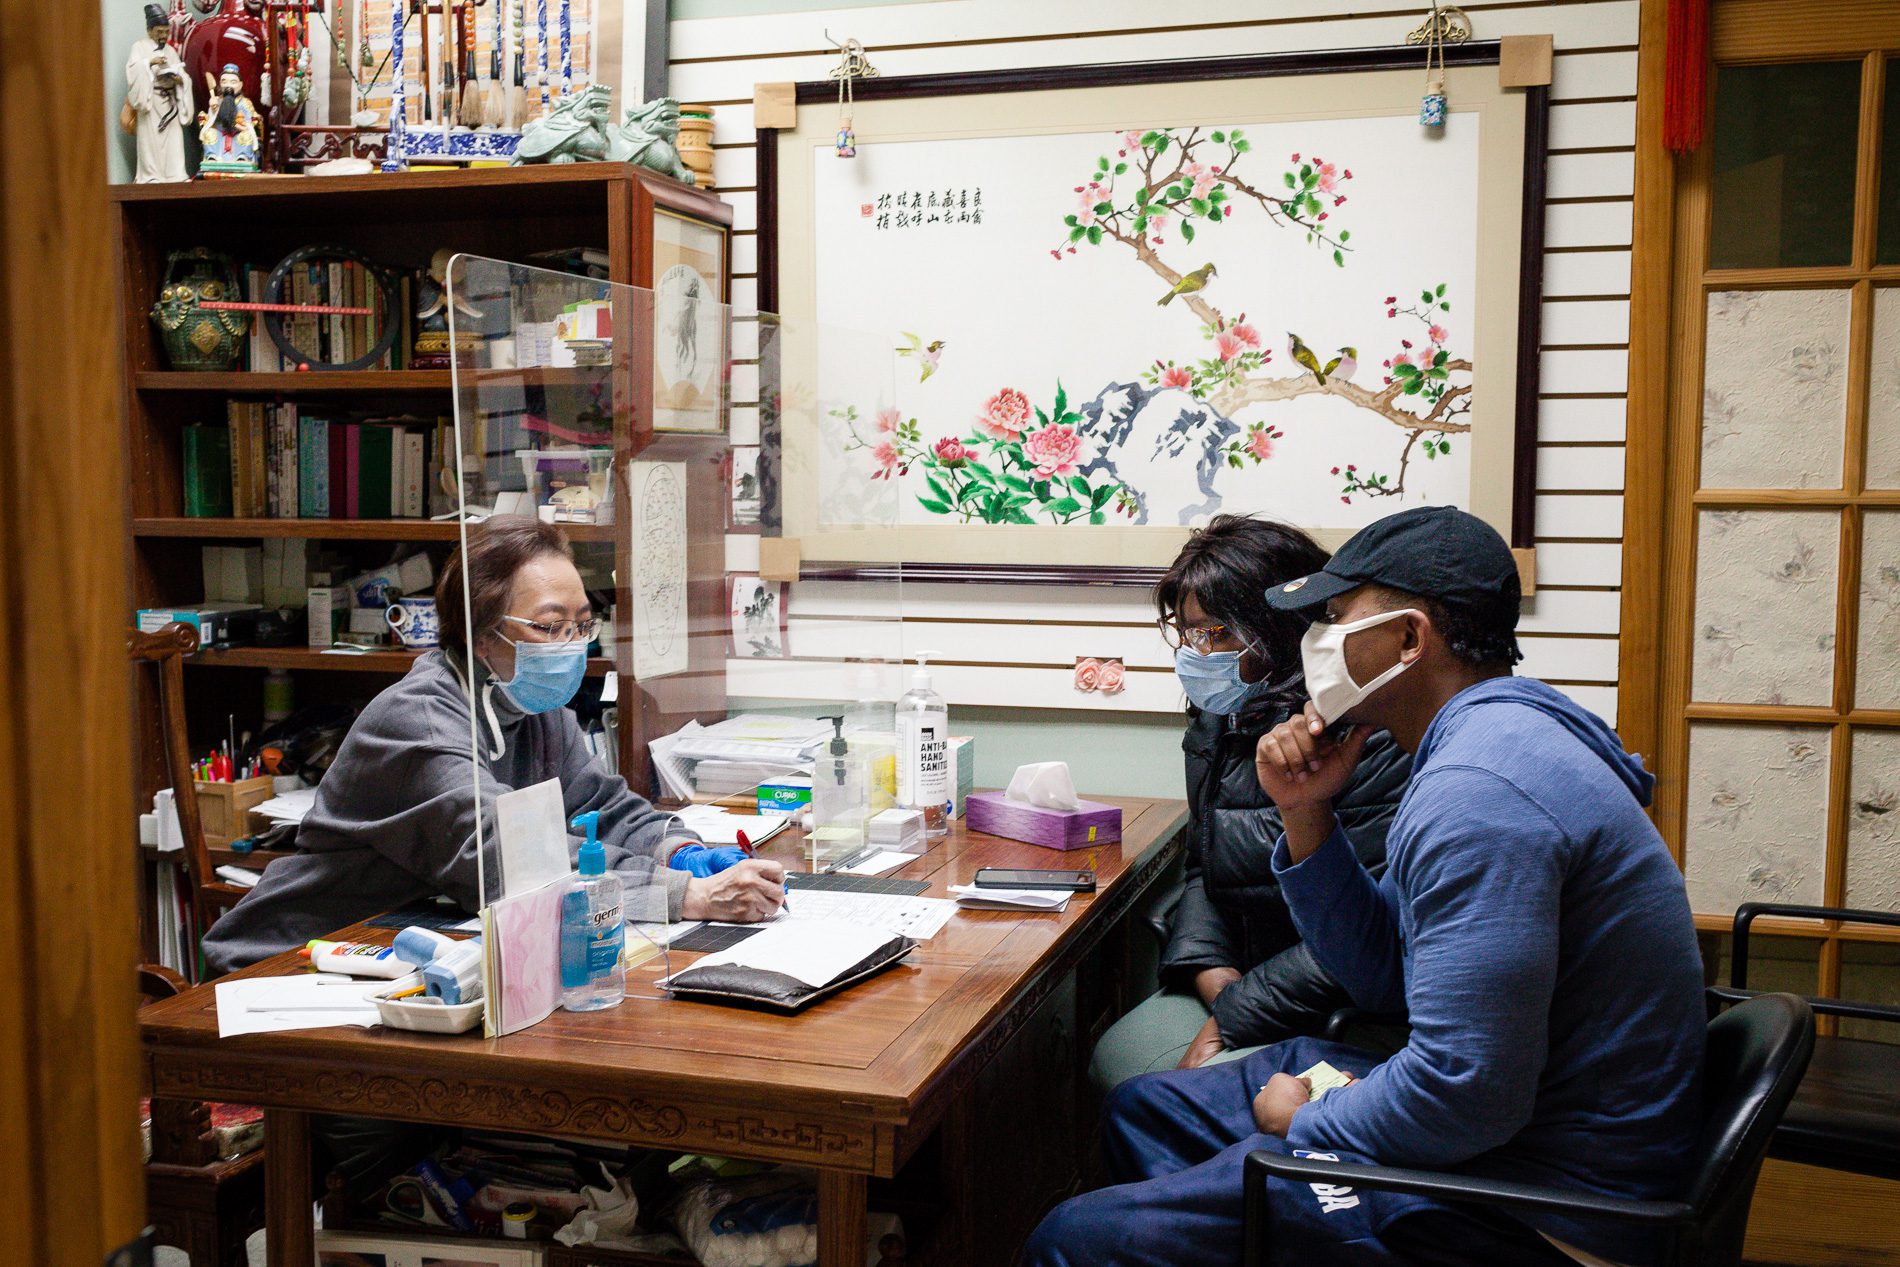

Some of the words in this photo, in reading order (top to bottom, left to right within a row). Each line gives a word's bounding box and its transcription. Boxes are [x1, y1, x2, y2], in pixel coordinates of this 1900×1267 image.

[920, 752, 943, 762] HAND
[774, 790, 797, 799] CURAD
[1309, 1182, 1361, 1214] BA
